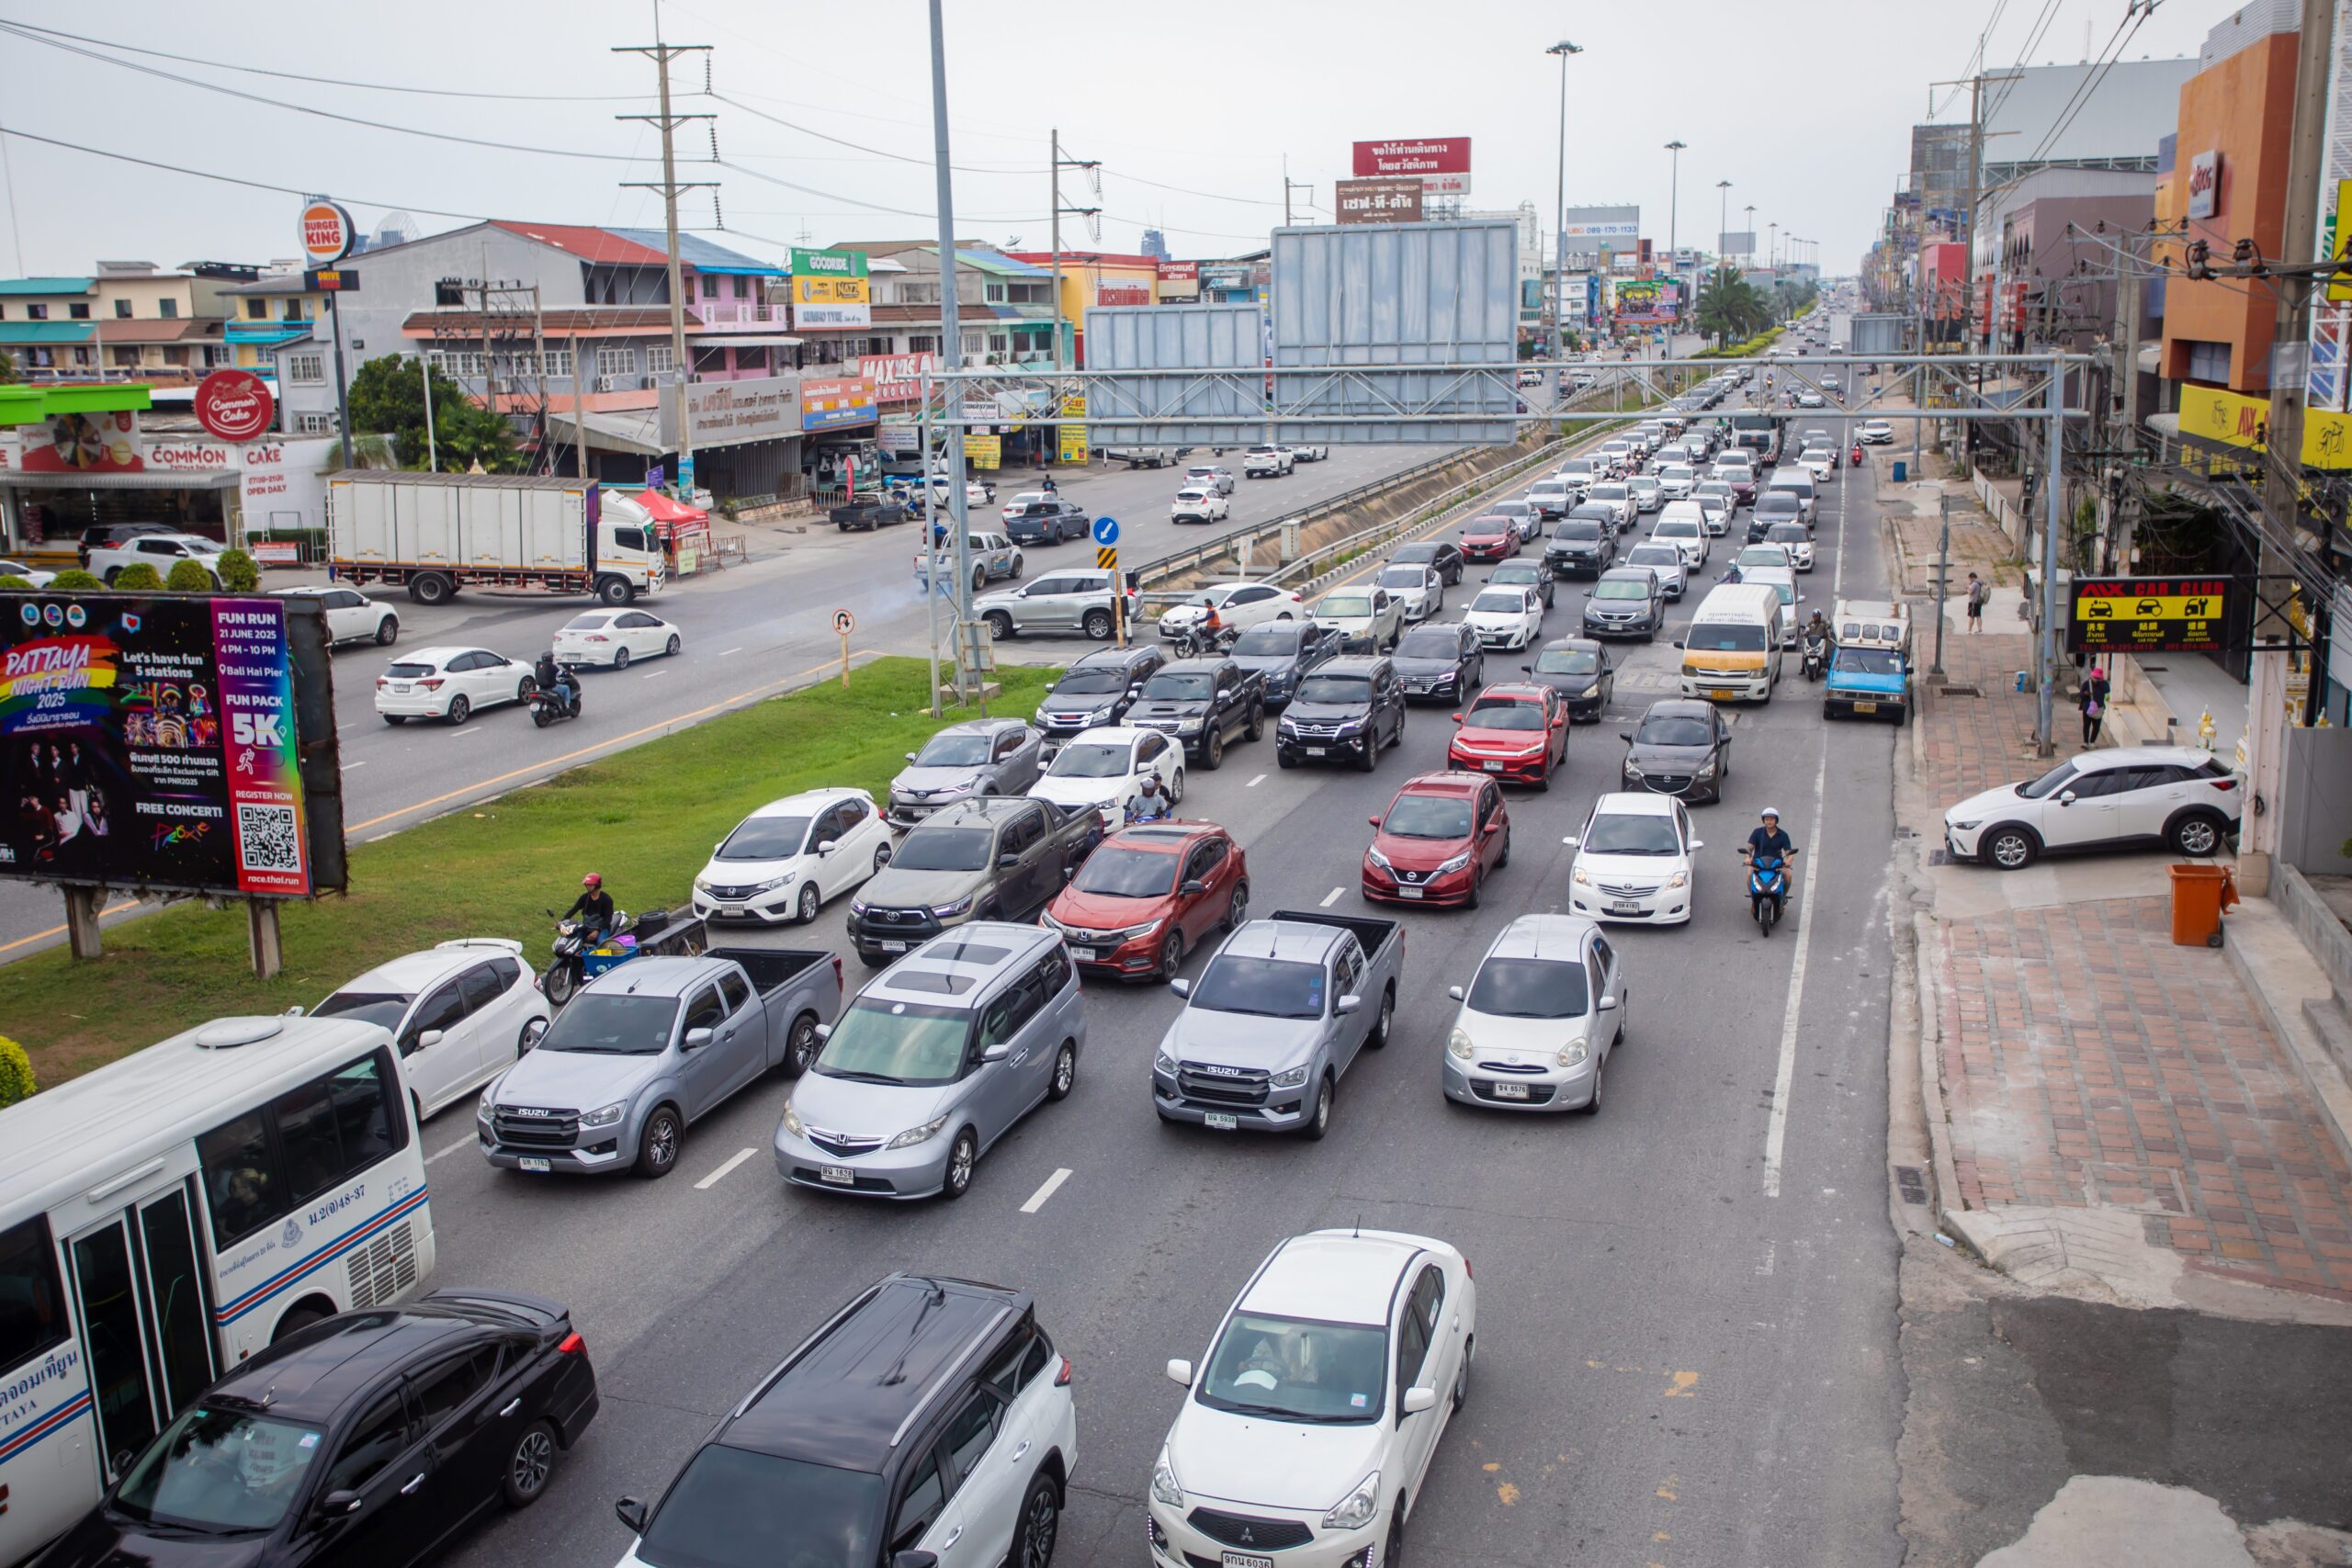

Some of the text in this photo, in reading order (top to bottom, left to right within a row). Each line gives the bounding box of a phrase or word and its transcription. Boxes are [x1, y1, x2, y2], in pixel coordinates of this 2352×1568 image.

[1372, 141, 1448, 156] ขอให้ท่านเดินทาง
[1377, 158, 1439, 171] โดยสวัสดิภาพ
[304, 220, 340, 231] BURGER
[306, 231, 341, 244] KING
[864, 358, 916, 385] MAXXIS
[211, 399, 256, 412] Common
[220, 409, 250, 423] Cake
[152, 448, 281, 465] COMMON CAKE
[247, 484, 287, 496] OPEN DAILY
[2135, 582, 2169, 596] CAR
[2179, 581, 2225, 595] CLUB
[218, 612, 277, 625] FUN RUN
[220, 629, 277, 639] 21 JUNE 2025
[220, 645, 227, 653] 4
[228, 646, 242, 654] PM
[250, 646, 261, 654] 10
[262, 647, 276, 655] PM
[6, 644, 90, 675] PATTAYA
[123, 651, 203, 665] Let's have fun
[135, 665, 193, 678] 5 stations
[227, 666, 283, 677] Bali Hai Pier
[10, 672, 90, 695] NIGHT RUN
[37, 693, 66, 709] 2025
[225, 694, 284, 706] FUN PACK
[232, 713, 284, 746] 5K
[161, 755, 180, 764] 500
[182, 754, 219, 766] ท่านแรก
[173, 767, 205, 776] Exclusive
[167, 777, 198, 785] PNR2025
[235, 790, 293, 801] REGISTER NOW
[135, 802, 223, 818] FREE CONCERT!
[247, 874, 300, 885] race.thai.run
[1207, 1066, 1239, 1076] ISUZU
[518, 1108, 549, 1117] ISUZU
[0, 1400, 37, 1429] TAYA
[1225, 1554, 1271, 1568] 9กน 6036
